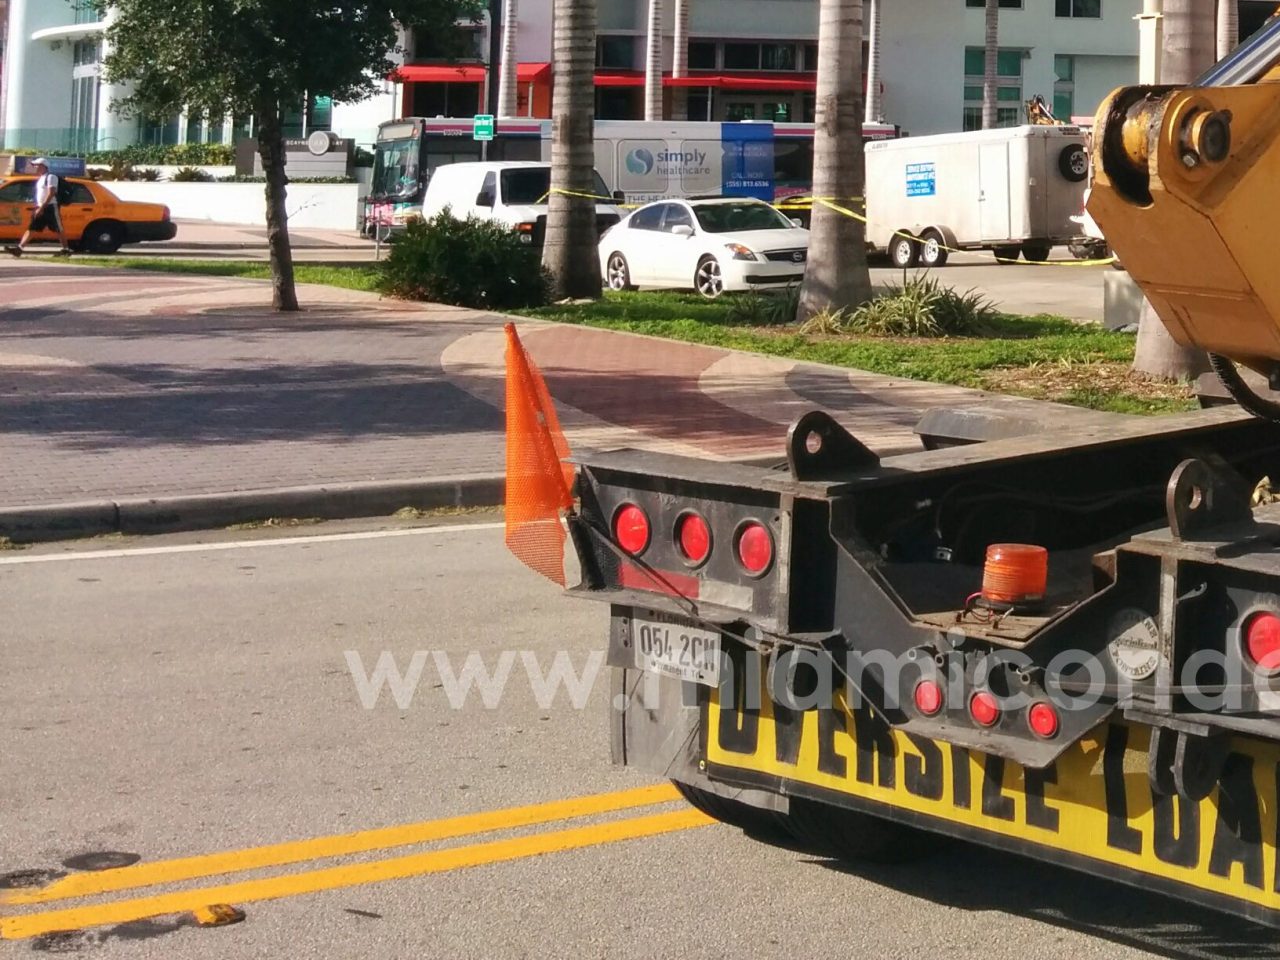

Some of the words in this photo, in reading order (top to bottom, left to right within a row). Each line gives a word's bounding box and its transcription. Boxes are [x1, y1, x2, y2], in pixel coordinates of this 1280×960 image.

[656, 148, 707, 164] simply
[656, 166, 711, 175] healthcare
[640, 624, 673, 661] 054
